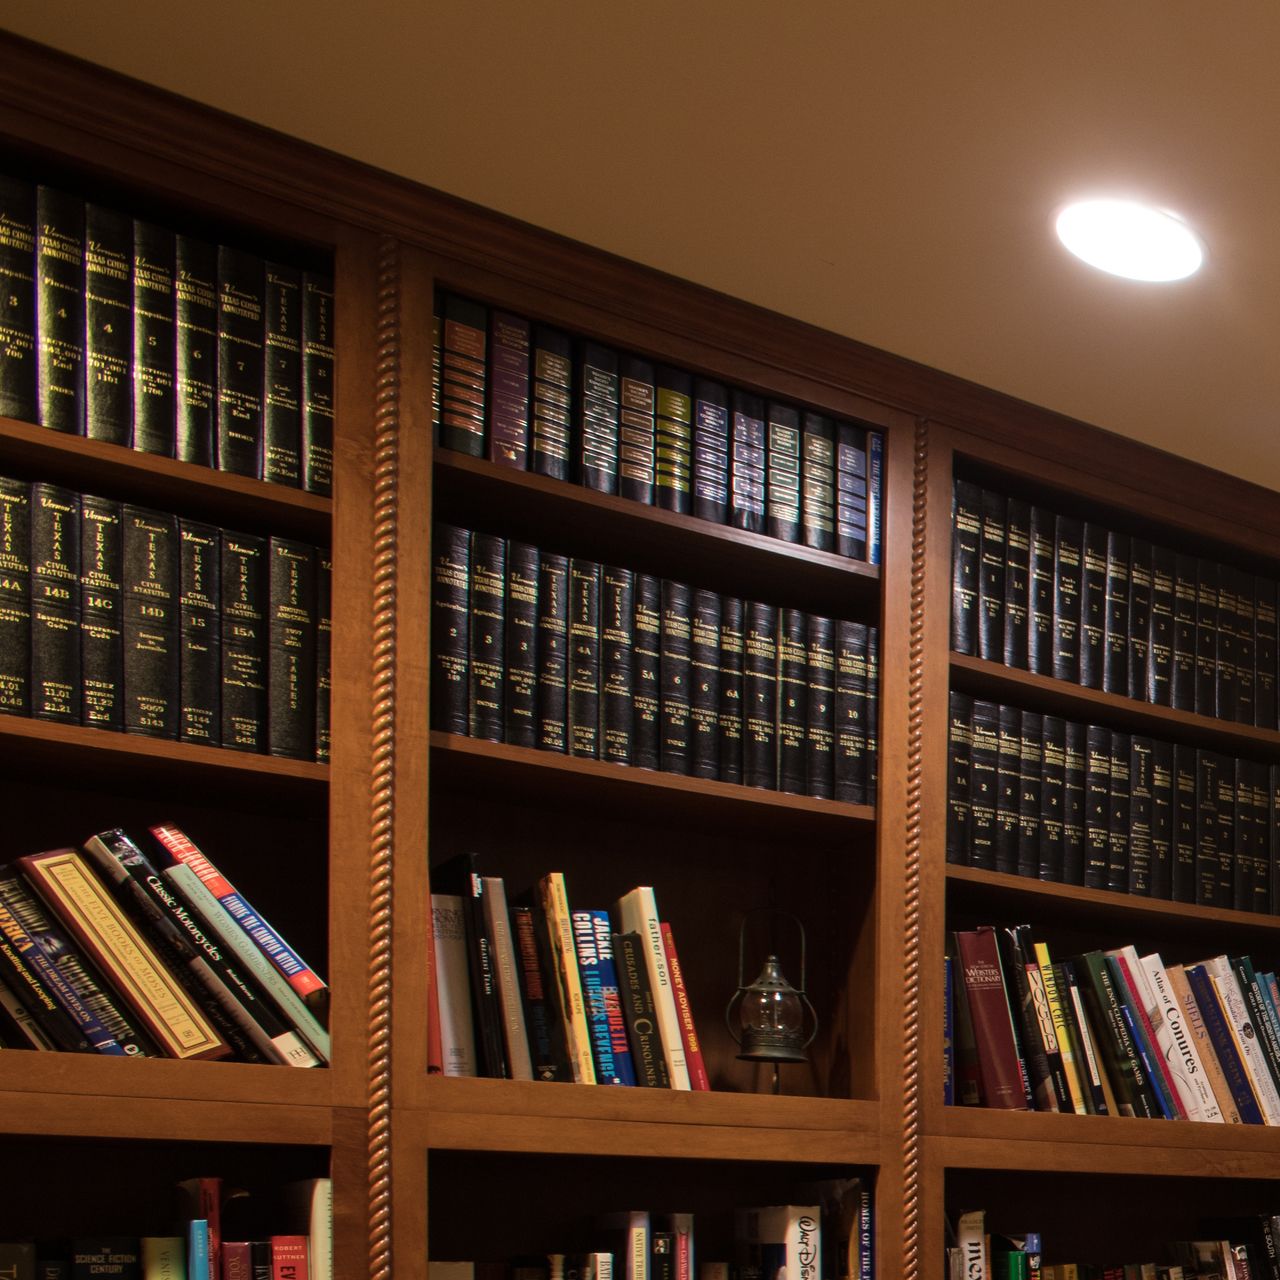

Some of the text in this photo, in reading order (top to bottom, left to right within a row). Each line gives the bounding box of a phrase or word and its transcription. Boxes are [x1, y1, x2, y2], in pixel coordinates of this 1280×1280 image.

[36, 567, 77, 581] STATUTES
[44, 587, 70, 599] 14B
[81, 577, 120, 590] STATUTES
[133, 587, 170, 599] STATUTES
[140, 606, 165, 617] 14D
[146, 875, 176, 907] Classic
[173, 906, 223, 961] Motorcycles
[593, 918, 614, 960] JACKIE
[573, 913, 598, 966] COLLINS
[649, 919, 662, 961] father
[671, 958, 684, 993] MONEY
[678, 992, 693, 1029] ADVISER
[1030, 972, 1057, 1049] VOGUE
[1167, 1007, 1198, 1075] Conures
